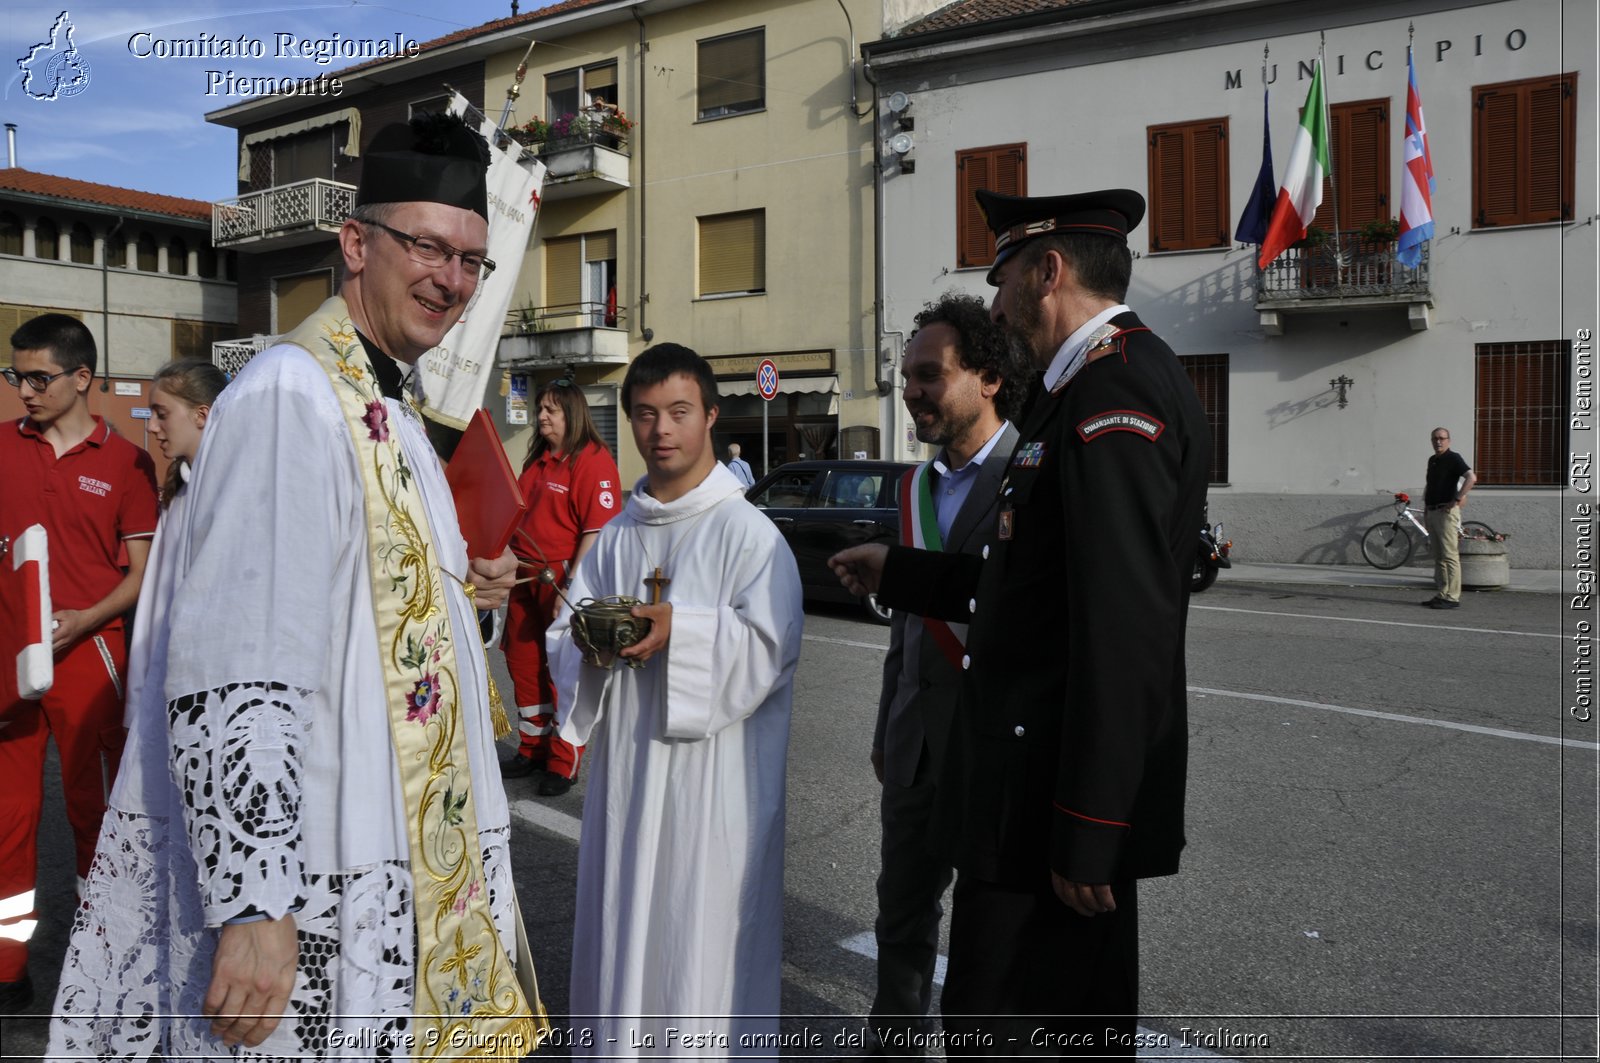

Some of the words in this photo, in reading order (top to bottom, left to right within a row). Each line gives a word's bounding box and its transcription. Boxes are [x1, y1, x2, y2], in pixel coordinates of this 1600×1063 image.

[1083, 416, 1121, 434] COMANDANTE
[1122, 416, 1129, 424] DI
[1129, 417, 1158, 434] STAZIONE
